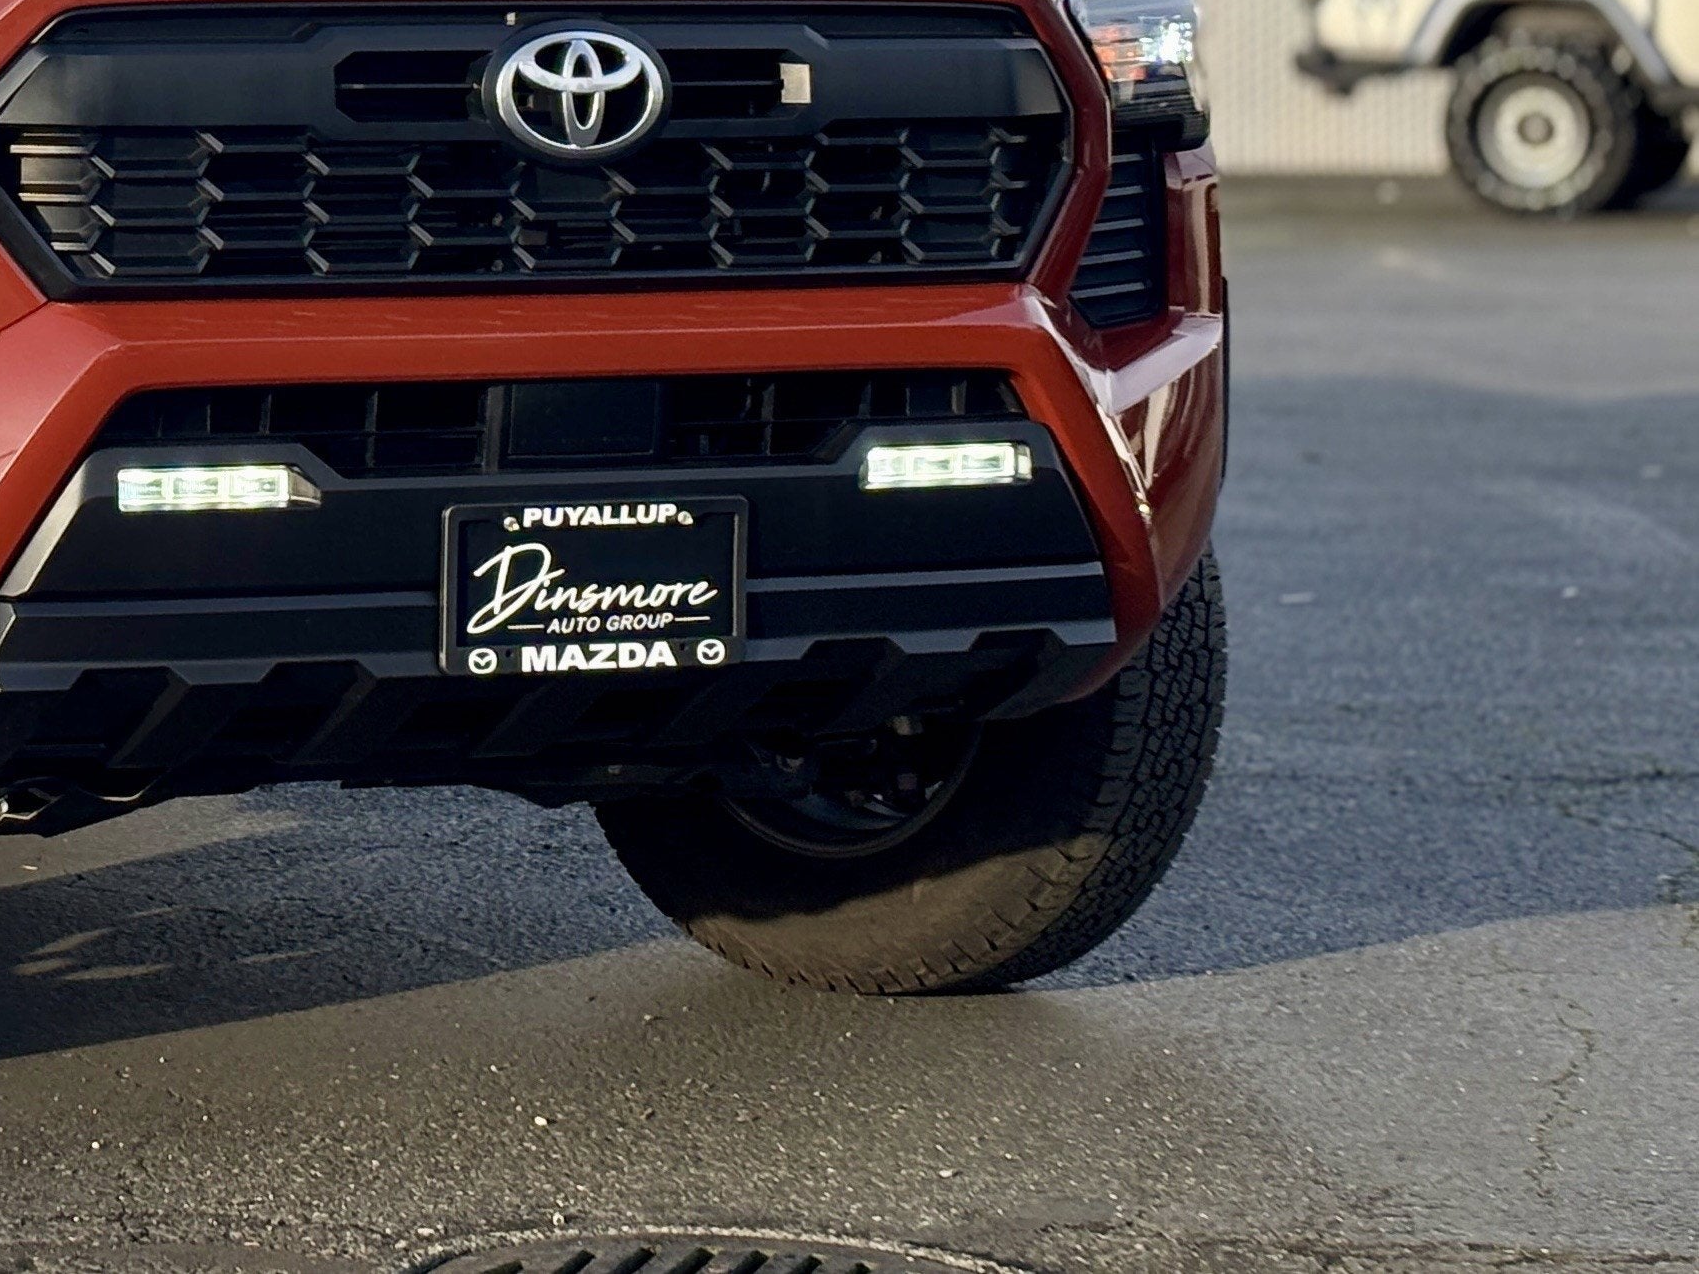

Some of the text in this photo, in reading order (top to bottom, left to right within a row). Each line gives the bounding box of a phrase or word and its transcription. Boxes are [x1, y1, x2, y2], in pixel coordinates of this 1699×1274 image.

[522, 503, 678, 528] PUYALLUP
[467, 542, 719, 635] Dinsmore
[546, 612, 674, 634] AUTO GROUP
[521, 640, 678, 672] MAZDA
